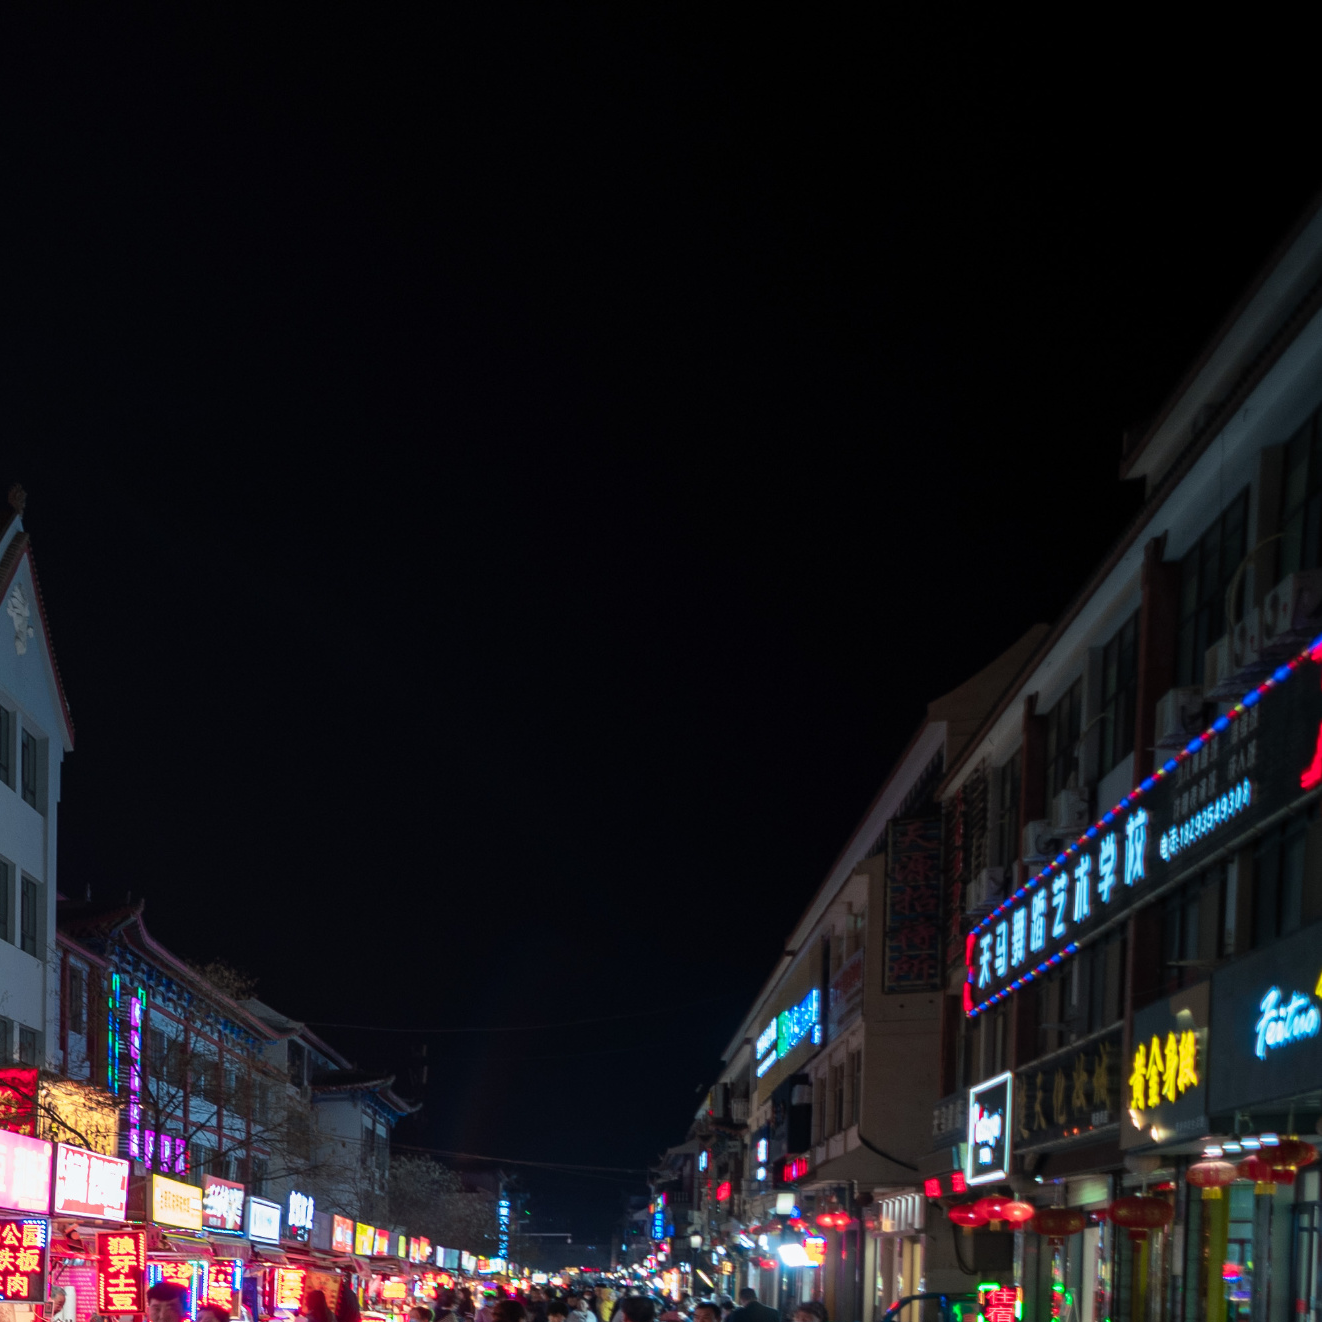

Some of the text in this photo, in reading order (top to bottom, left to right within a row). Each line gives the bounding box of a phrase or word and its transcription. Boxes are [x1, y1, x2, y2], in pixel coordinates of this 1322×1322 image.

[978, 807, 1150, 989] 天马舞蹈艺术学校
[107, 1236, 138, 1311] 狼牙土豆
